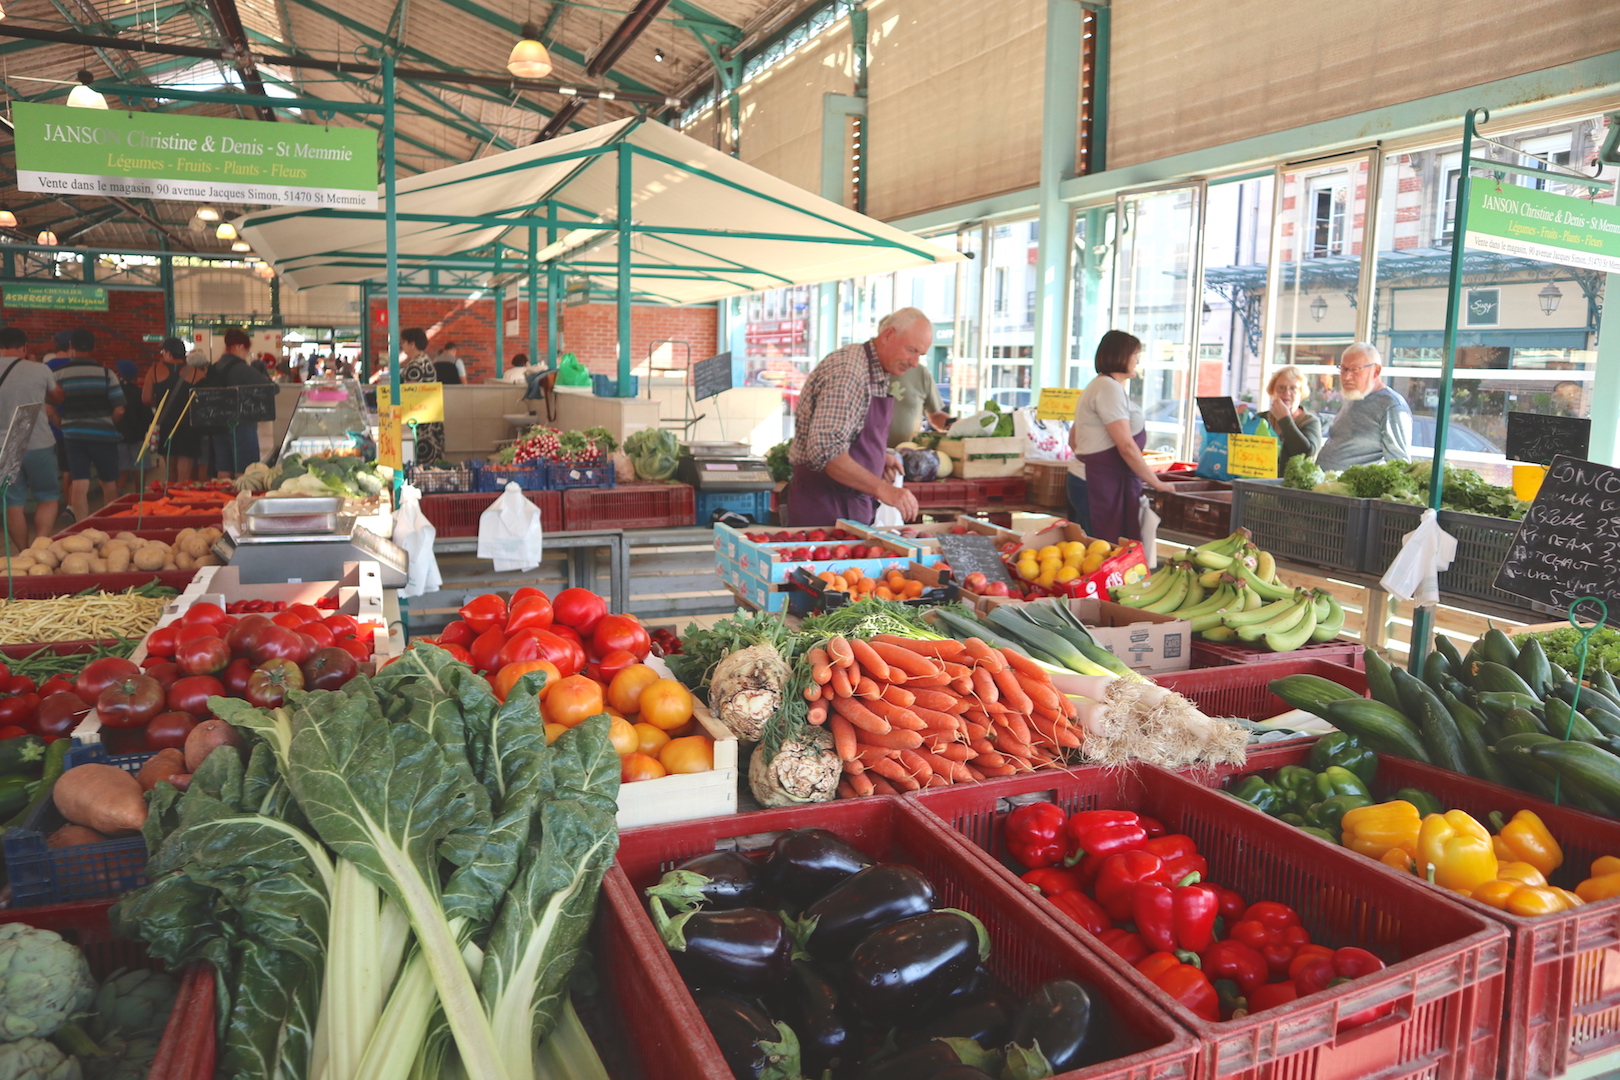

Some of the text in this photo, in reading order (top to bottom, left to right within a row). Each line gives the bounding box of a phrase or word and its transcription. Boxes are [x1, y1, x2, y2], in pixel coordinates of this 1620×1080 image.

[44, 124, 120, 145] JANSON
[127, 130, 198, 151] Christine
[201, 136, 216, 152] &
[220, 136, 264, 156] Denis
[276, 141, 290, 157] St
[294, 143, 352, 161] Memmie
[107, 153, 164, 172] Légumes
[176, 157, 212, 172] Fruits
[224, 160, 260, 176] Plants
[271, 164, 307, 178] Fleurs
[38, 176, 366, 205] Vente dans le magasin, 90 avenue Jacques Simon, 51470 St Memmie
[1482, 194, 1520, 214] JANSON
[1520, 202, 1554, 221] Christine
[1554, 210, 1563, 223] &
[1563, 210, 1585, 228] Denis
[1590, 217, 1598, 230] St
[1508, 220, 1536, 235] Légumes
[1540, 226, 1558, 240] Fruits
[1562, 230, 1581, 244] Plants
[1584, 234, 1603, 248] Fleurs
[1474, 236, 1488, 247] Vente
[1490, 240, 1500, 249] dans
[1501, 240, 1506, 250] le
[1536, 250, 1551, 258] avenue
[1553, 251, 1570, 263] Jacques
[5, 294, 52, 303] ASPERGES
[1470, 299, 1497, 315] Suzy
[1155, 322, 1183, 331] corner
